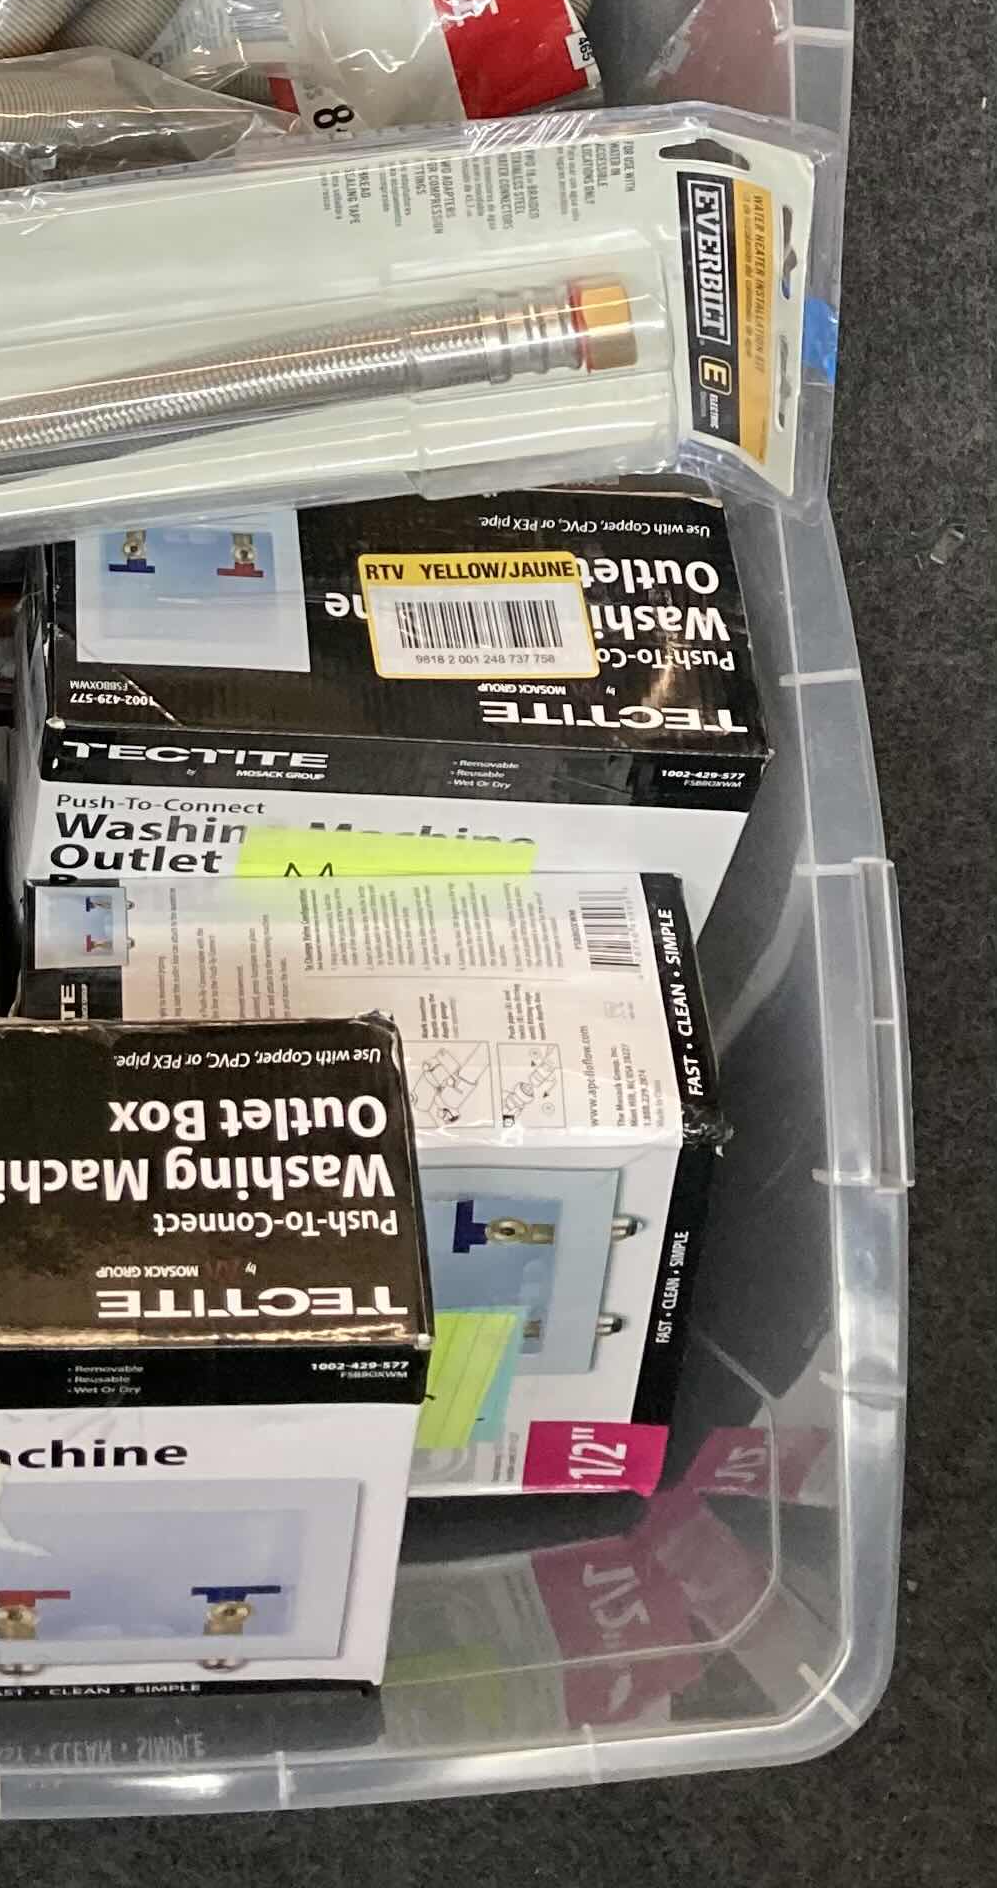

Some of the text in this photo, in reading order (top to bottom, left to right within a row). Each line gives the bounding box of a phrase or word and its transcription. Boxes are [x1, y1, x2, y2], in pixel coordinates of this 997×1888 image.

[752, 194, 764, 234] WATER
[693, 187, 726, 338] EVERBILT
[754, 234, 766, 278] HEATER
[703, 362, 727, 387] E
[478, 516, 710, 538] Use with Copper, CPVC, or PEX pipe.
[364, 560, 574, 581] RTV YELLOW/JAUNE
[415, 654, 531, 665] 9818 001 737
[70, 693, 154, 707] 1002-429-577
[477, 683, 566, 696] MOSACK GROUP
[478, 699, 749, 733] TECTITE
[62, 741, 330, 769] TECTITE
[459, 759, 520, 770] Removable
[236, 769, 326, 781] MOSACK GROUP
[455, 769, 505, 779] Reusable
[661, 768, 746, 781] 1002-429-577
[57, 794, 267, 816] Push-To-Connect
[50, 843, 223, 875] Outlet
[657, 908, 704, 1097] FAST CLEAN SIMPLE
[113, 1048, 382, 1069] Use with Copper, CPVC, or PEX pipe.
[108, 1094, 388, 1141] Outlet Box
[165, 1147, 396, 1199] Washing
[153, 1209, 400, 1239] Push-To-Connect
[96, 1261, 257, 1279] by MOSACK GROUP
[654, 1230, 690, 1344] FAST CLEAN SIMPLE
[96, 1285, 409, 1319] TECTITE
[75, 1365, 144, 1374] Removable
[311, 1361, 410, 1372] 1002-429-577
[74, 1375, 131, 1384] Reusable
[568, 1426, 628, 1480] 1/2"
[48, 1686, 111, 1697] CLEAN
[134, 1683, 202, 1695] SIMPLE
